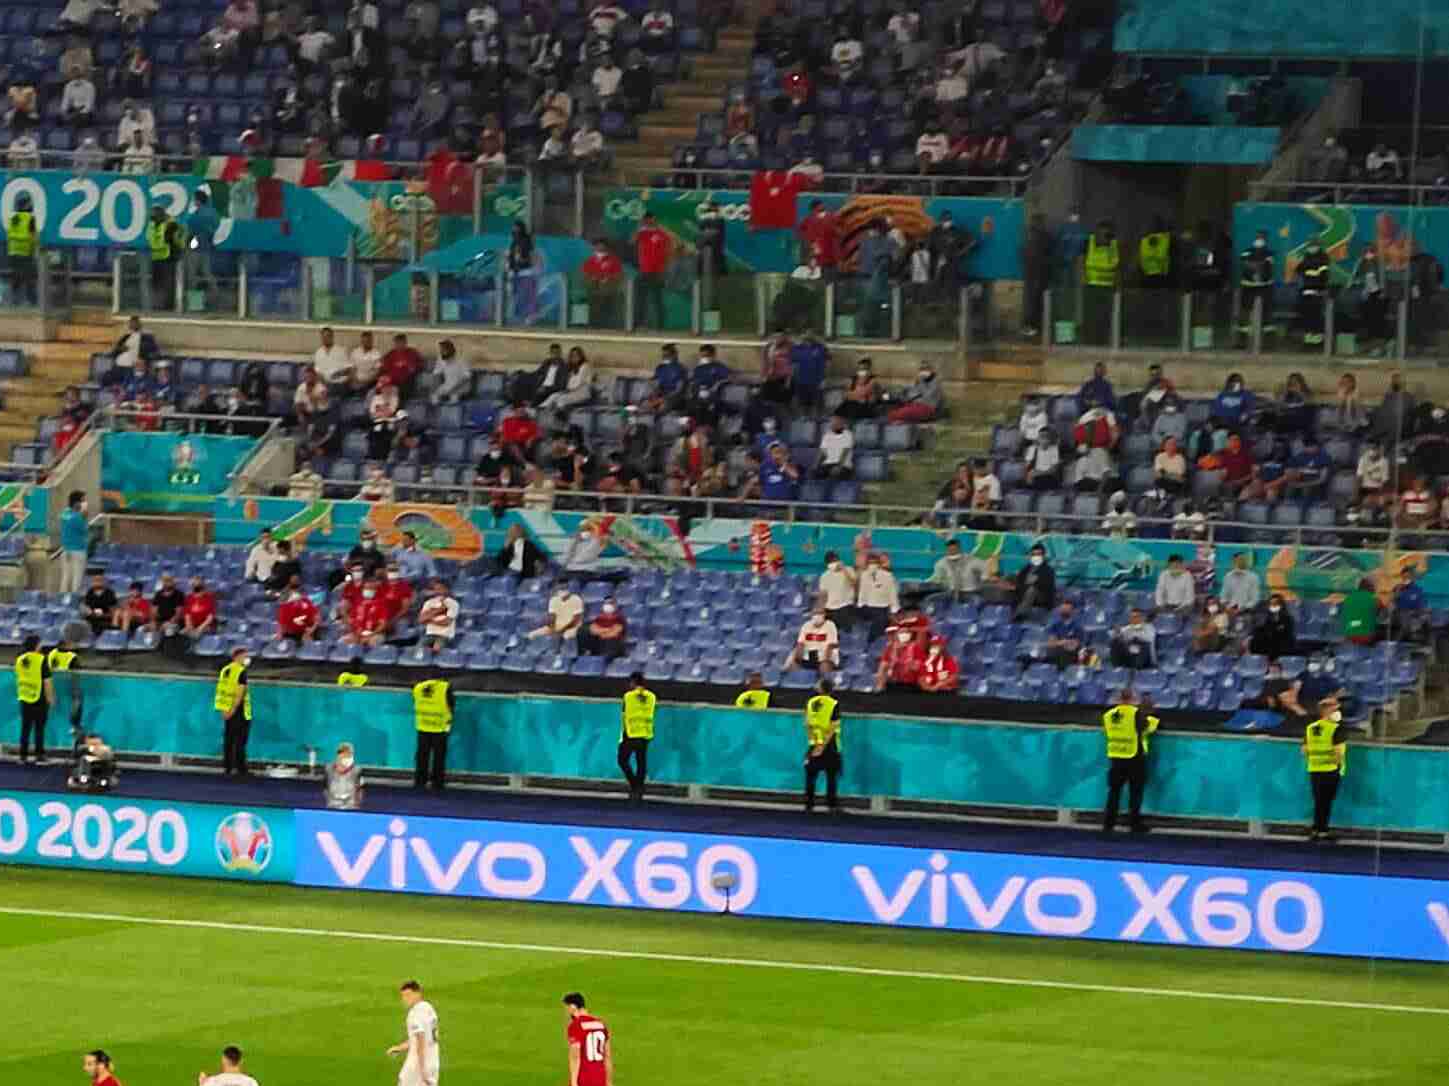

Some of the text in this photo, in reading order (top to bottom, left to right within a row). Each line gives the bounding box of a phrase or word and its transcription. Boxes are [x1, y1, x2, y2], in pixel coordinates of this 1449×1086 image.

[58, 178, 233, 246] 202
[37, 801, 189, 866] 2020
[315, 817, 758, 912] vivo X60
[850, 851, 1324, 951] vivo X60
[585, 1031, 606, 1062] 10
